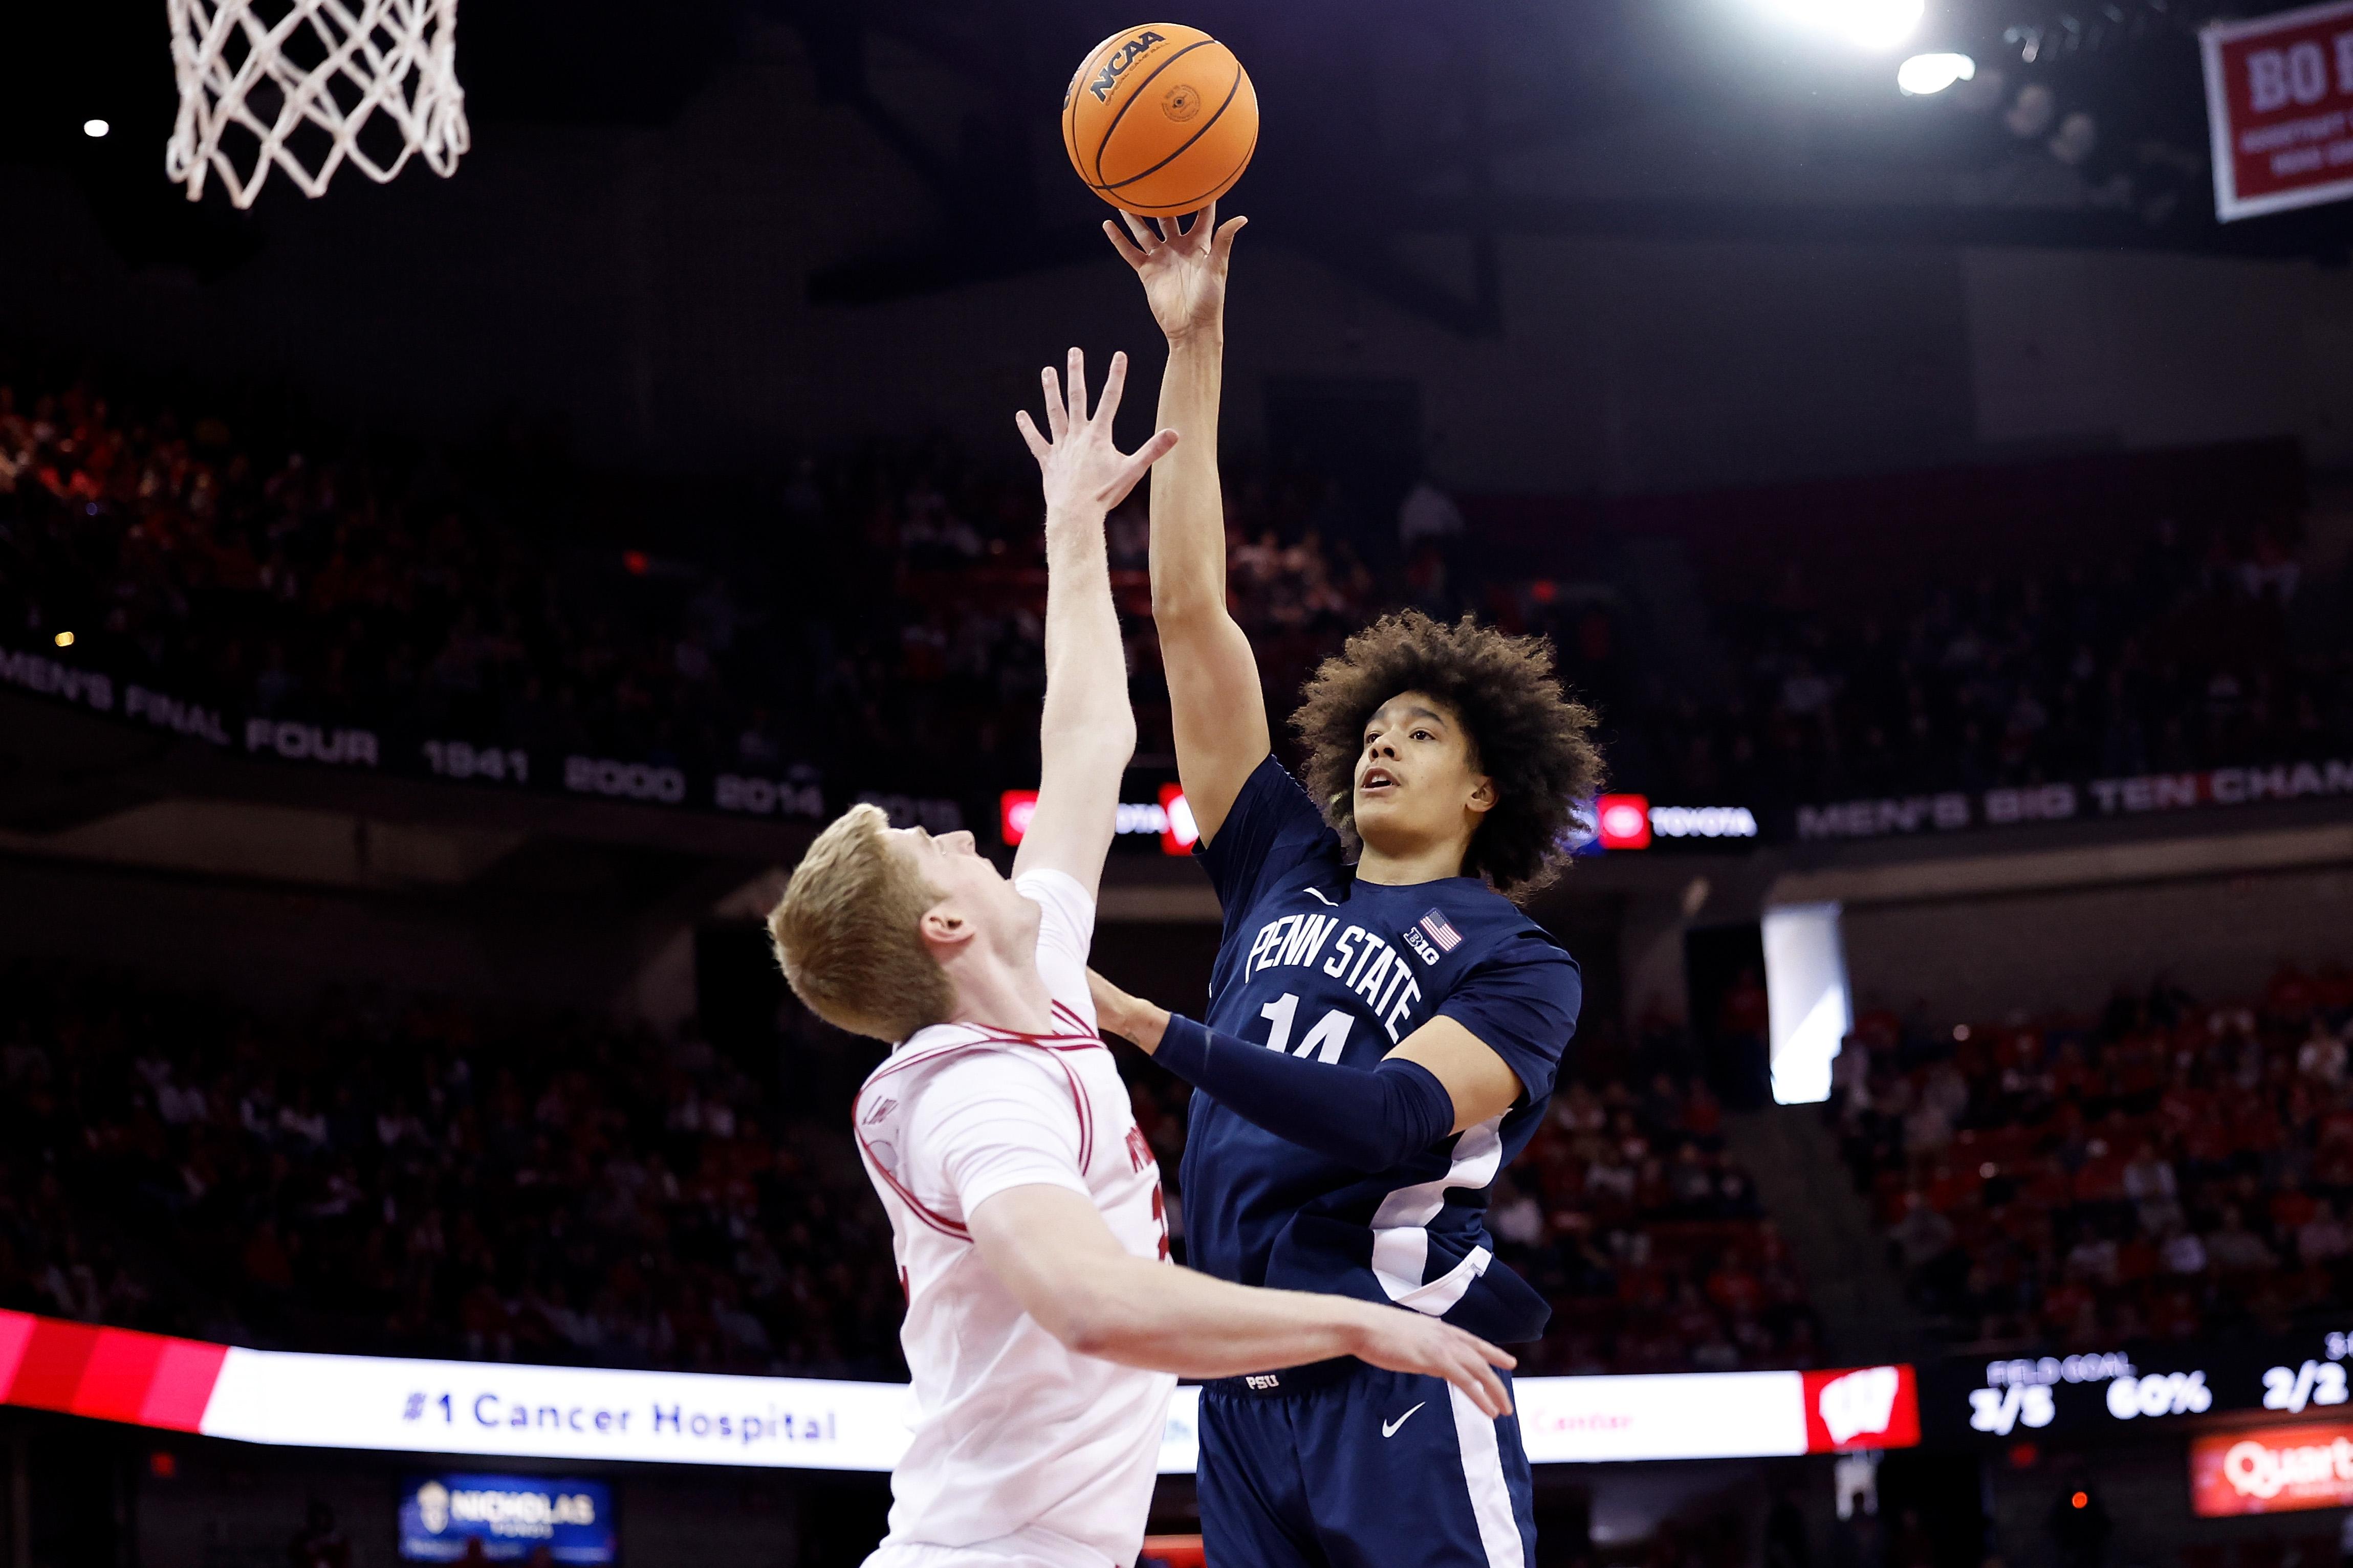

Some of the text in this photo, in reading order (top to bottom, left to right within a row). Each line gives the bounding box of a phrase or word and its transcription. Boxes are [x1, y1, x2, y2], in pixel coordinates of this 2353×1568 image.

[1089, 31, 1166, 103] NCAA
[2247, 42, 2328, 113] BO
[244, 717, 380, 767] FOUR
[421, 738, 530, 785] 1941
[562, 754, 687, 804] 2000
[1647, 806, 1758, 837] TOYOTA
[1794, 792, 1970, 839] MEN'S
[2088, 770, 2198, 814] TEN
[1245, 914, 1422, 1044] PENN STATE
[1260, 992, 1355, 1065] 14
[1246, 1374, 1279, 1389] PSU
[2106, 1370, 2213, 1420] 60%
[2262, 1359, 2349, 1414] 2/2
[403, 1393, 836, 1446] #1 Cancer Hospital
